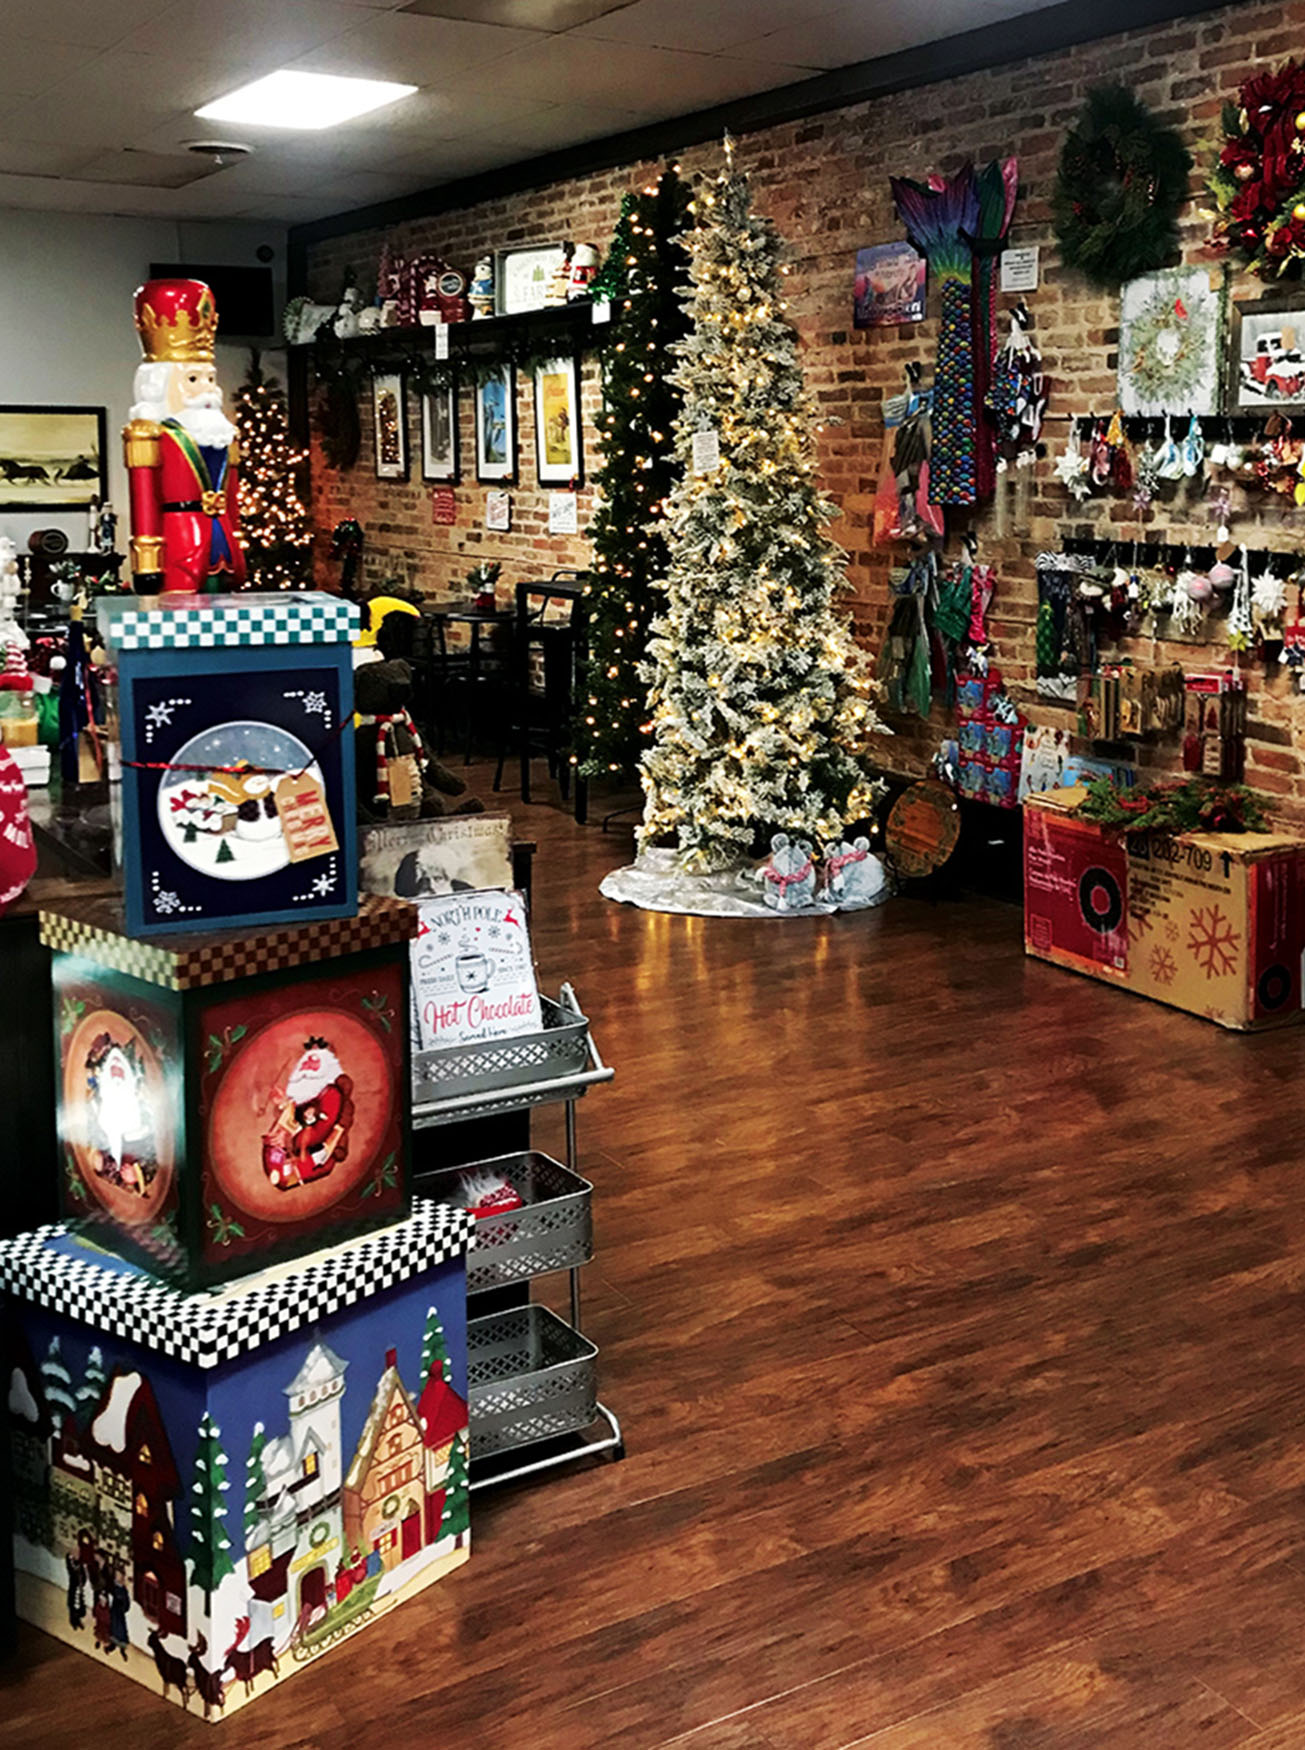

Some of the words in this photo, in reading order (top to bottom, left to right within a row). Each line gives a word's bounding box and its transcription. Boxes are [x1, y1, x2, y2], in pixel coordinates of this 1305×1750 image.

[296, 790, 332, 849] MERRY
[431, 904, 472, 928] NORTH
[473, 905, 503, 924] POLE
[424, 1001, 467, 1035] Hot
[468, 992, 535, 1029] Chocolate
